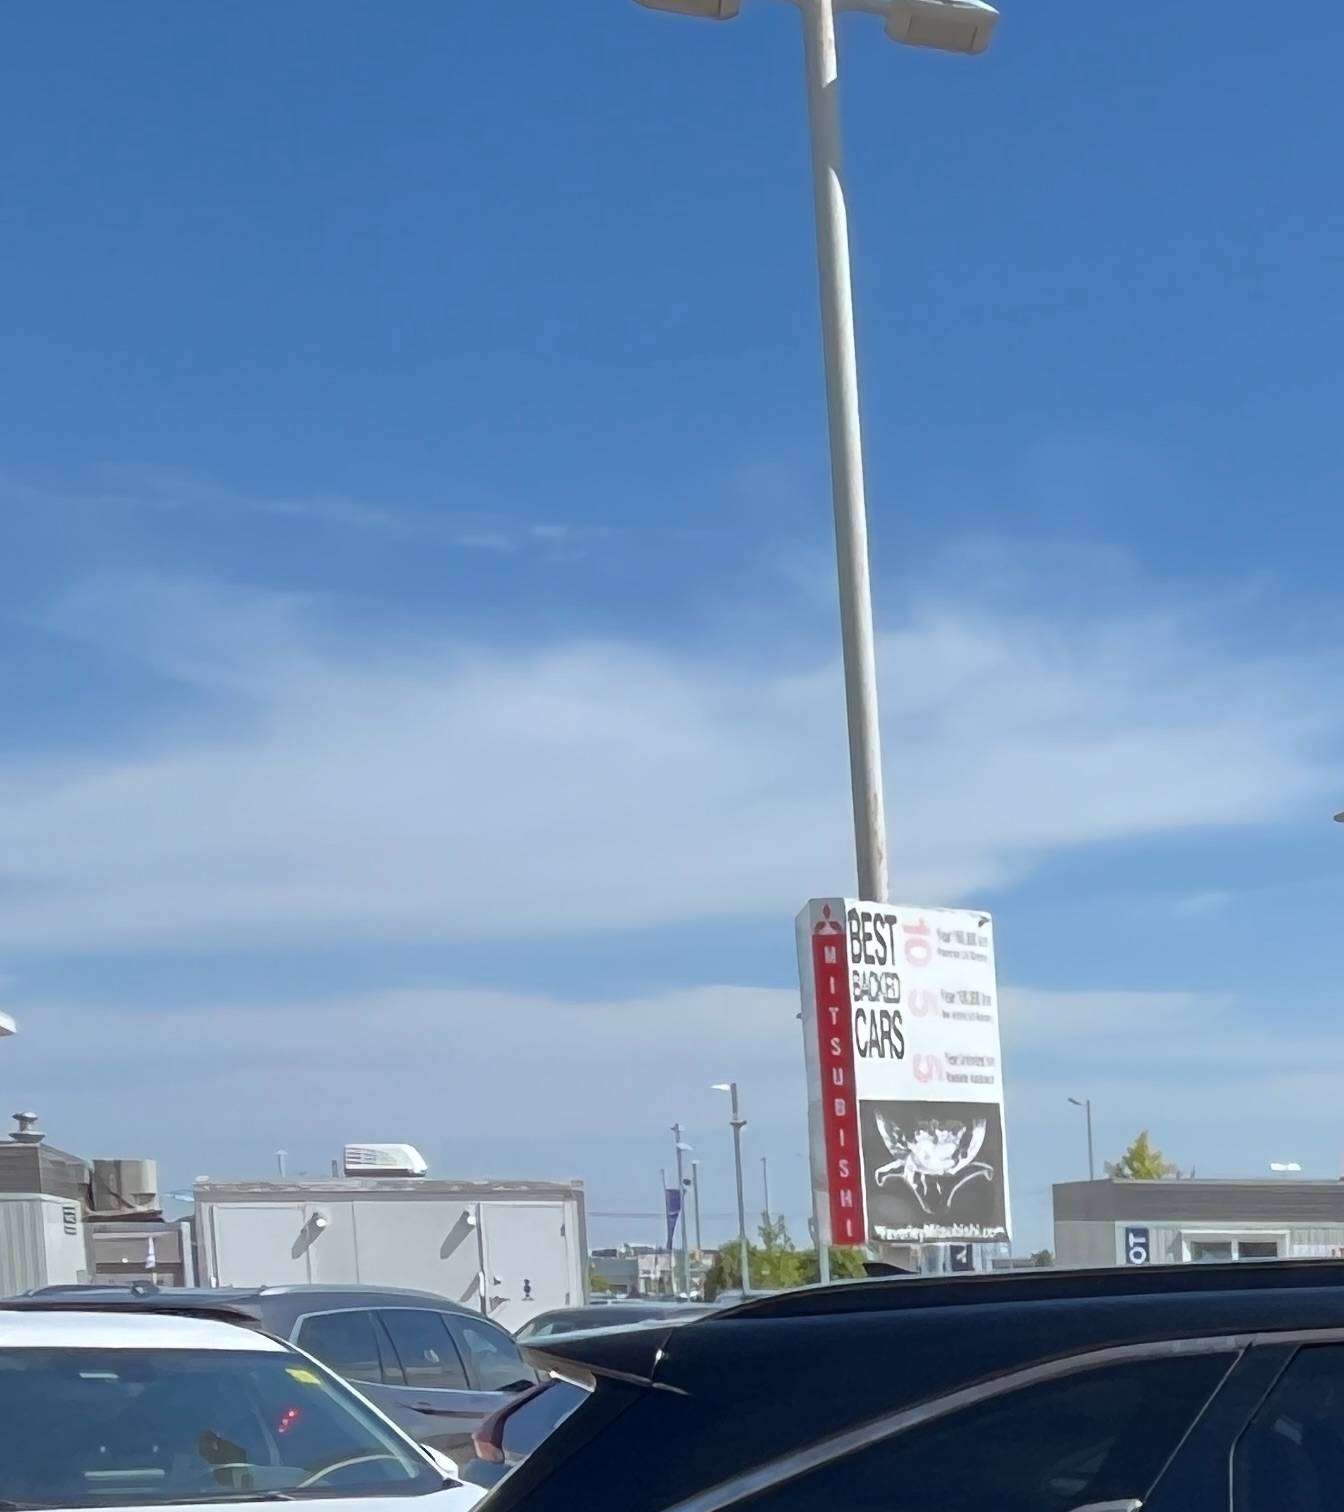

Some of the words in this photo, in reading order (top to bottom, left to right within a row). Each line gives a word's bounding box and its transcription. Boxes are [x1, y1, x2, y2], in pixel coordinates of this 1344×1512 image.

[848, 908, 897, 966] BEST
[855, 1008, 905, 1059] CARS
[823, 945, 853, 1238] MITSUBISHI
